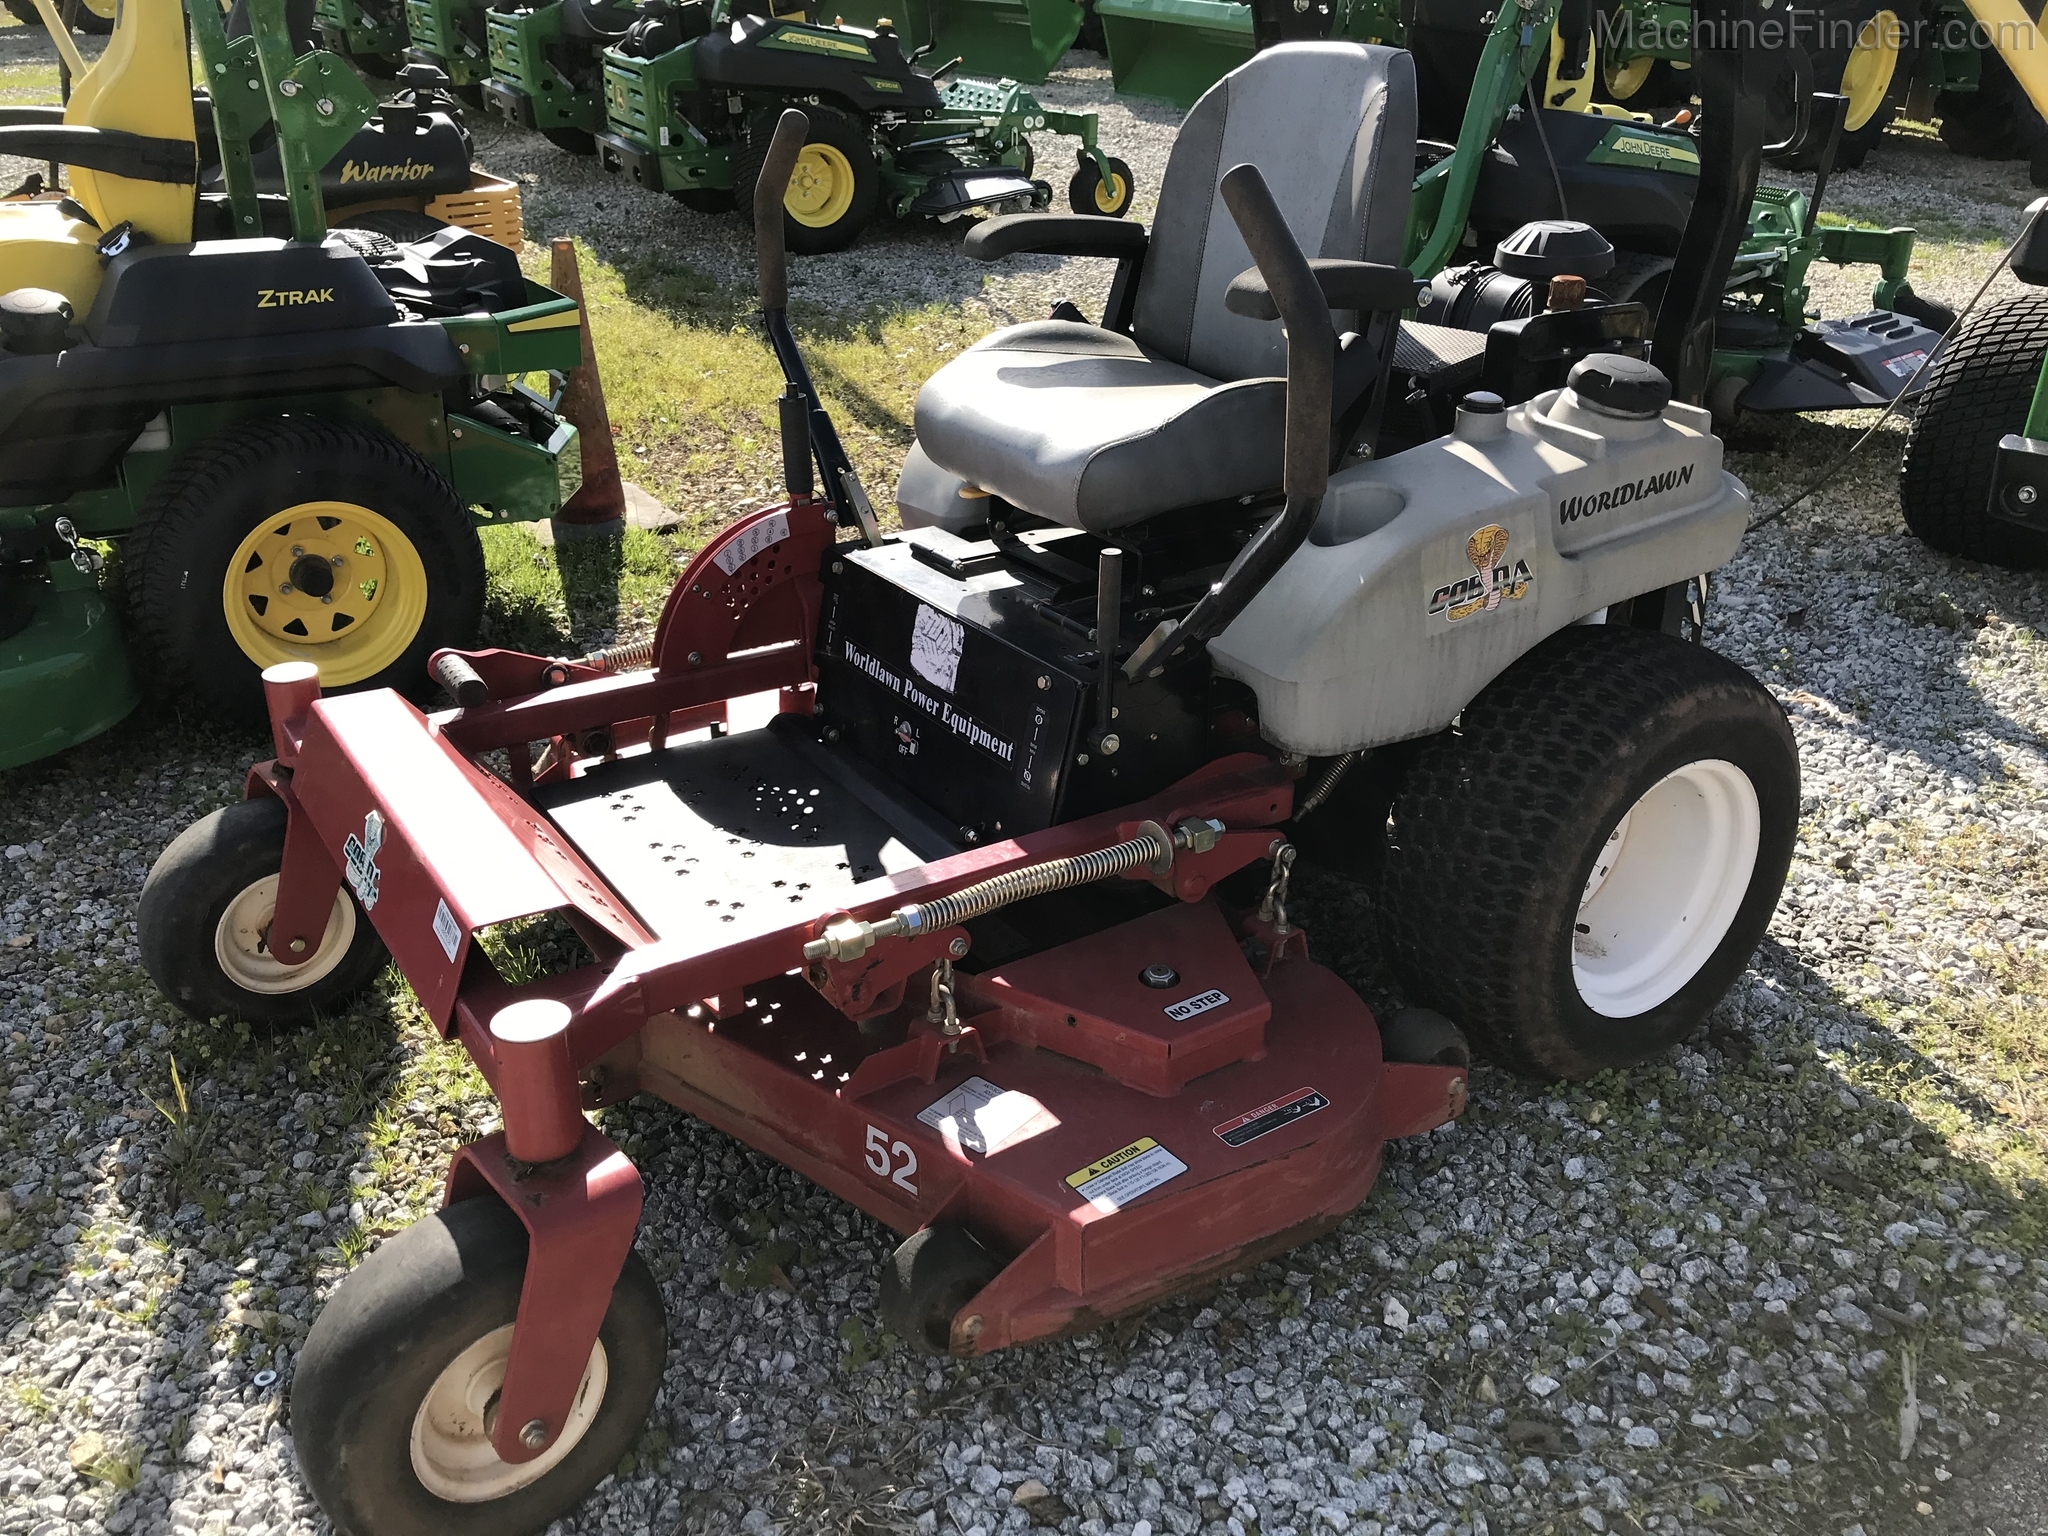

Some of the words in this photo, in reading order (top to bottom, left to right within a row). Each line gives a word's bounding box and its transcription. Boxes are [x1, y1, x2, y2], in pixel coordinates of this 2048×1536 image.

[788, 34, 809, 45] JOHN
[810, 38, 838, 49] DEERE
[1620, 139, 1642, 153] JOHN
[1643, 142, 1671, 159] DEERE
[340, 157, 435, 184] Warrior
[257, 288, 335, 308] ZTRAK
[1559, 463, 1694, 525] WORLDLAWN
[1428, 559, 1534, 615] COBRA
[845, 640, 901, 693] Worldlawn
[903, 678, 940, 716] Power
[941, 702, 1014, 762] Equipment
[893, 715, 899, 726] R
[915, 728, 920, 738] L
[898, 743, 909, 756] OFF
[1168, 1005, 1191, 1018] NO
[1189, 992, 1222, 1010] STEP
[1250, 1103, 1279, 1119] DANGER
[865, 1124, 918, 1196] 52
[1100, 1145, 1141, 1169] CAUTION
